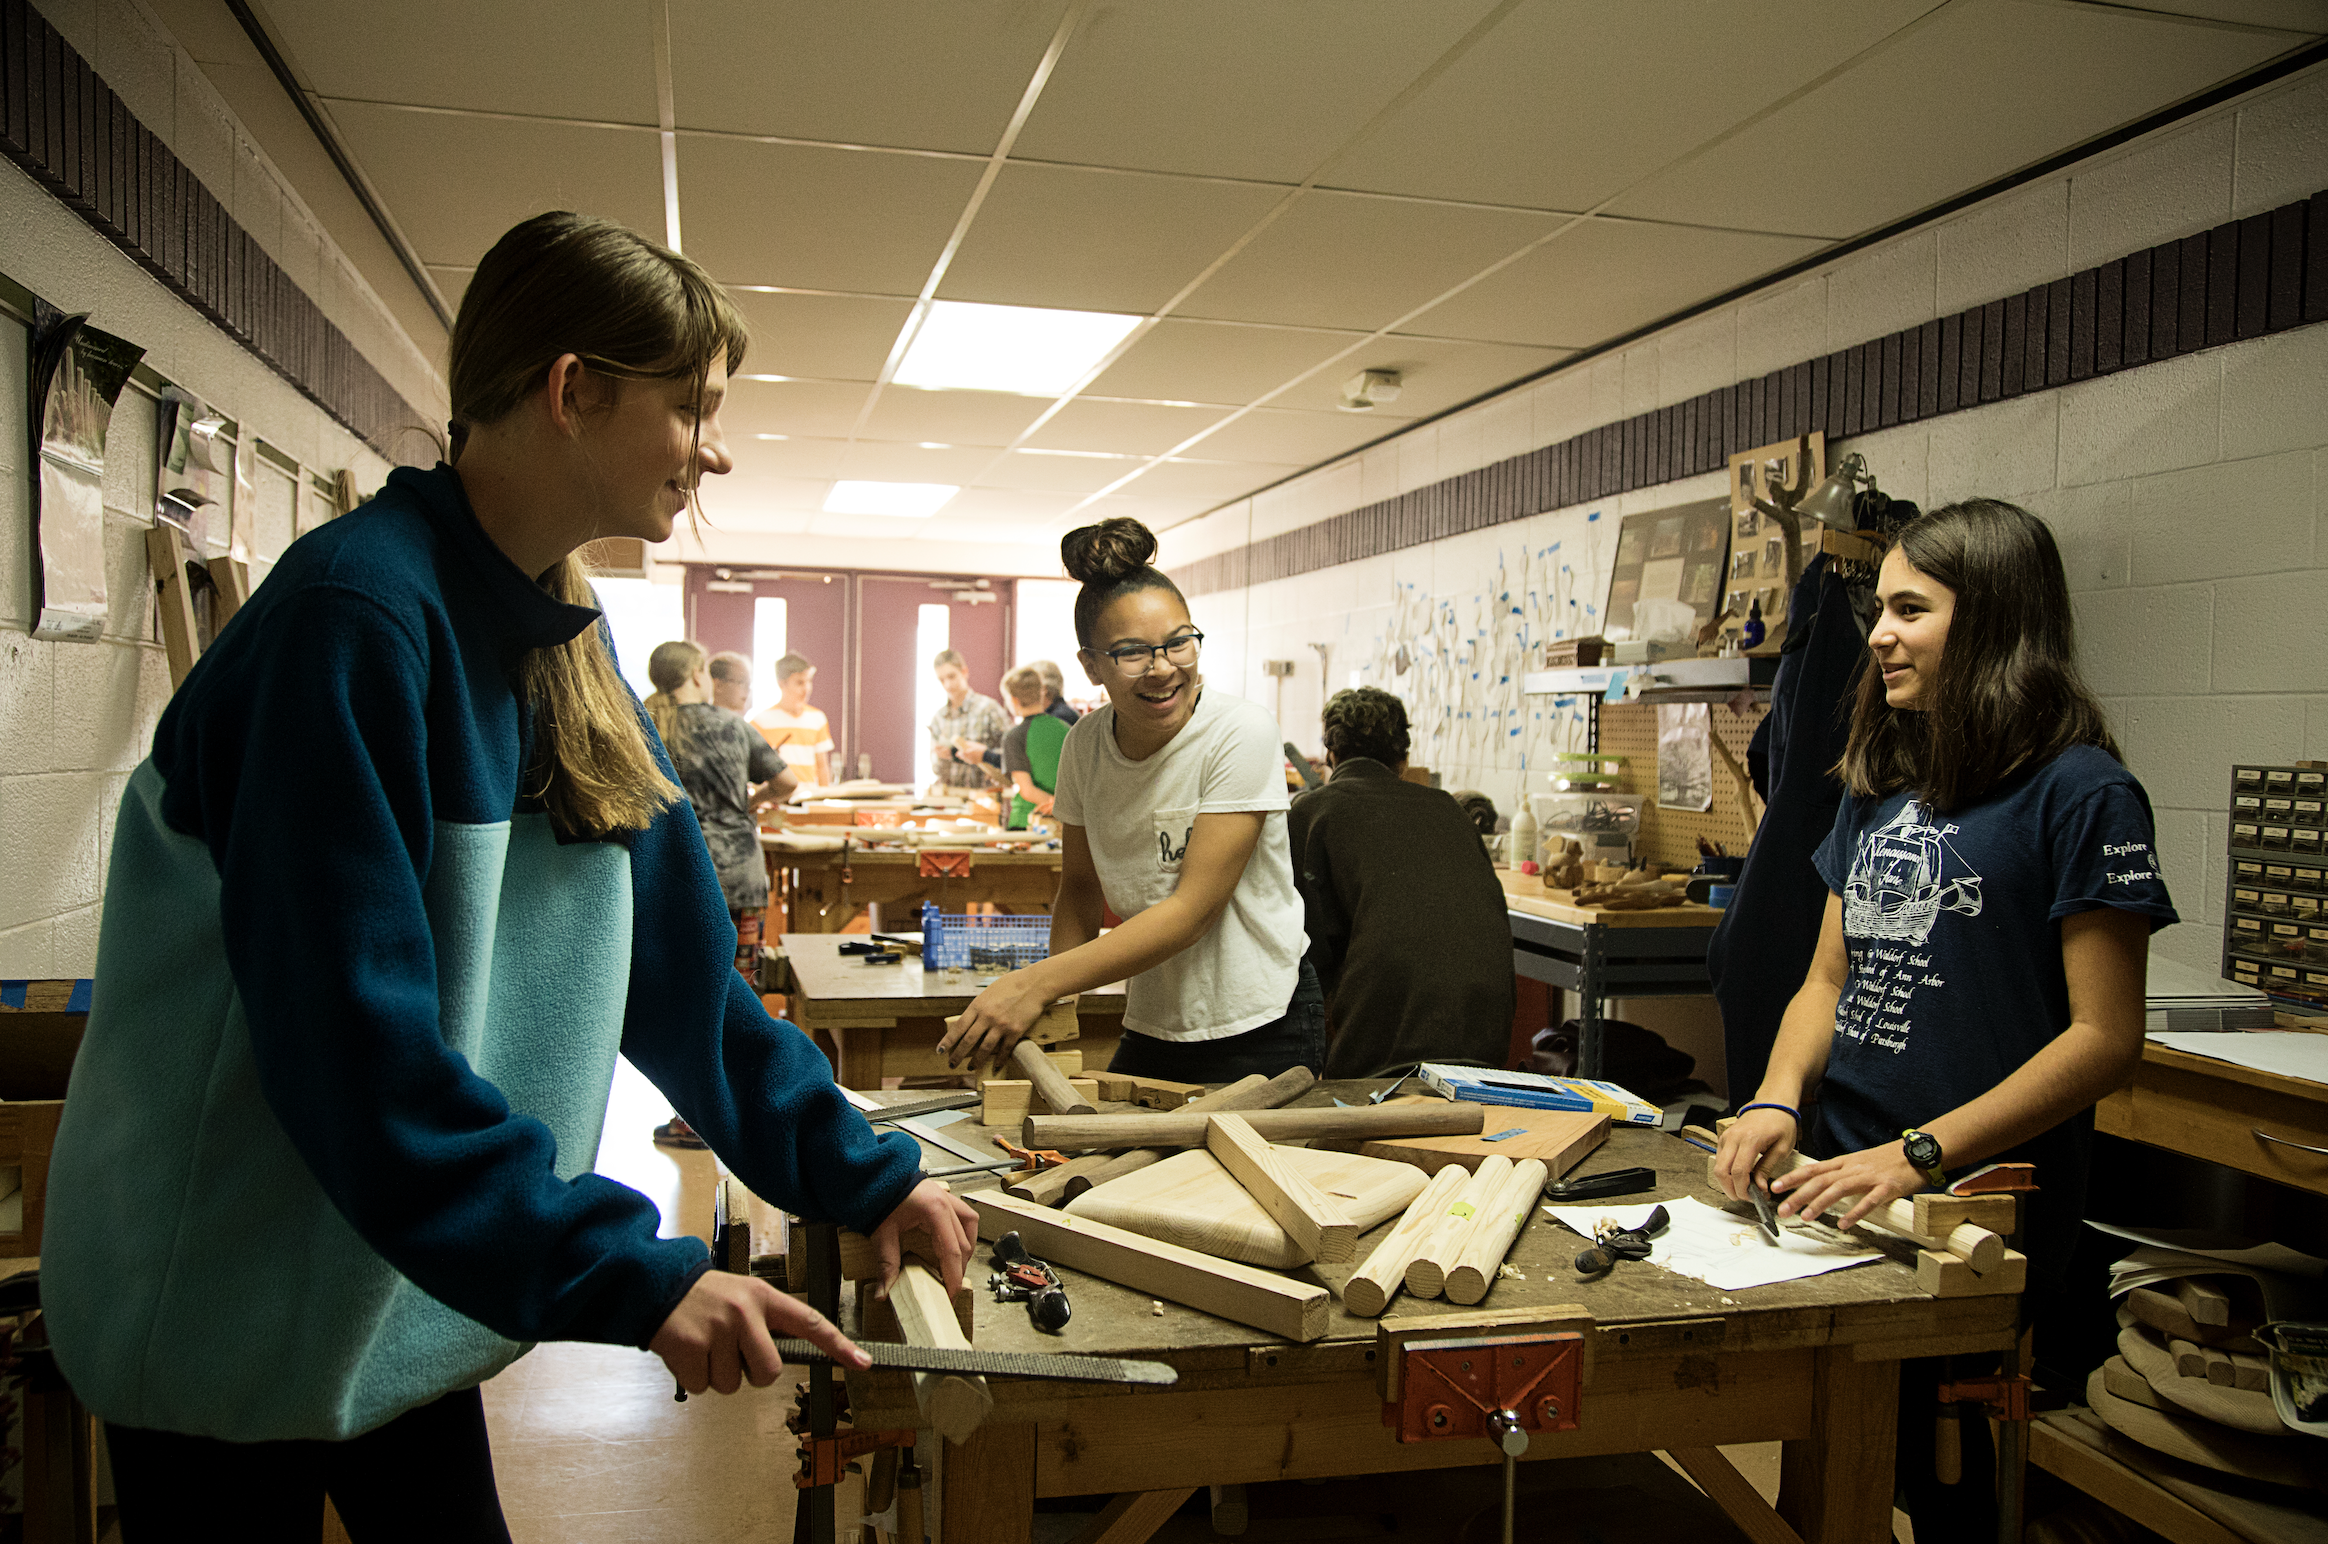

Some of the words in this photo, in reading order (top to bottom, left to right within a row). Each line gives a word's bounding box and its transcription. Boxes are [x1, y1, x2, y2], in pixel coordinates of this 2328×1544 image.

[2102, 841, 2148, 857] Explore
[2106, 869, 2153, 885] Explore
[1876, 948, 1908, 967] Waldorf
[1907, 953, 1933, 968] School
[1879, 965, 1891, 982] of
[1892, 970, 1913, 983] Ann
[1917, 973, 1946, 988] Arbor
[1862, 979, 1891, 998] Waldorf
[1890, 985, 1916, 999] School
[1883, 1000, 1908, 1015] School
[1875, 1018, 1912, 1034] Louisville
[1870, 1033, 1909, 1055] Pittsburgh
